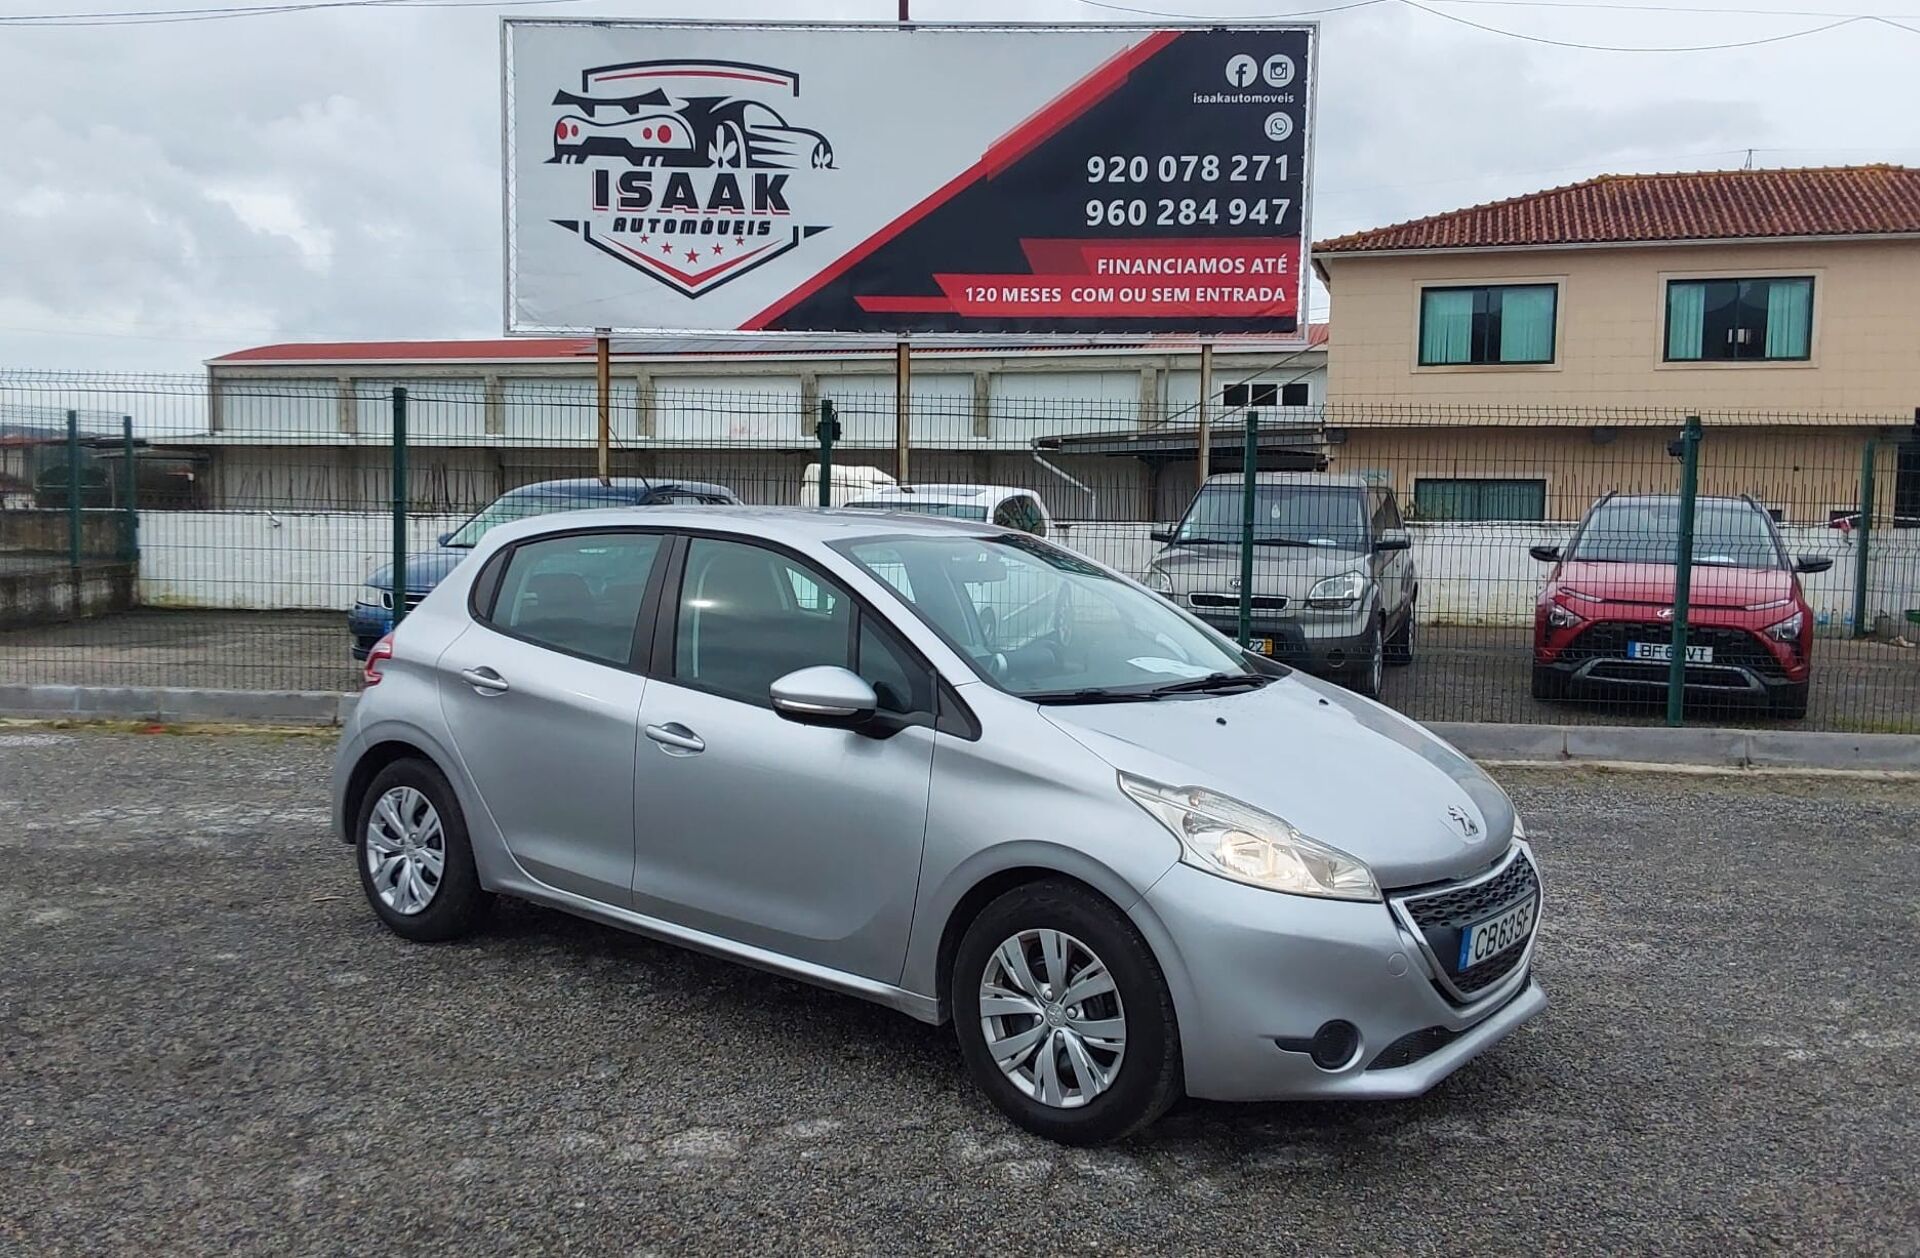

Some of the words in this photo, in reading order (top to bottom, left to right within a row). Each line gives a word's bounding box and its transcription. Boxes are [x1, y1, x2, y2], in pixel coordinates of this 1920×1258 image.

[1193, 92, 1295, 104] isaakautomoveis
[1087, 155, 1149, 183] 920
[1158, 154, 1220, 182] 078
[1229, 154, 1288, 181] 271
[592, 169, 791, 215] ISAAK
[1085, 199, 1147, 226] 960
[1156, 198, 1219, 225] 284
[1228, 198, 1291, 225] 947
[612, 217, 772, 236] AUTOMÓVEIS
[1097, 257, 1245, 275] FINANCIAMOS
[1250, 253, 1288, 274] ATÉ
[965, 287, 998, 302] 120
[1002, 287, 1062, 302] MESES
[1071, 287, 1114, 302] COM
[1119, 287, 1147, 302] OU
[1151, 287, 1190, 302] SEM
[1195, 287, 1286, 302] ENTRADA
